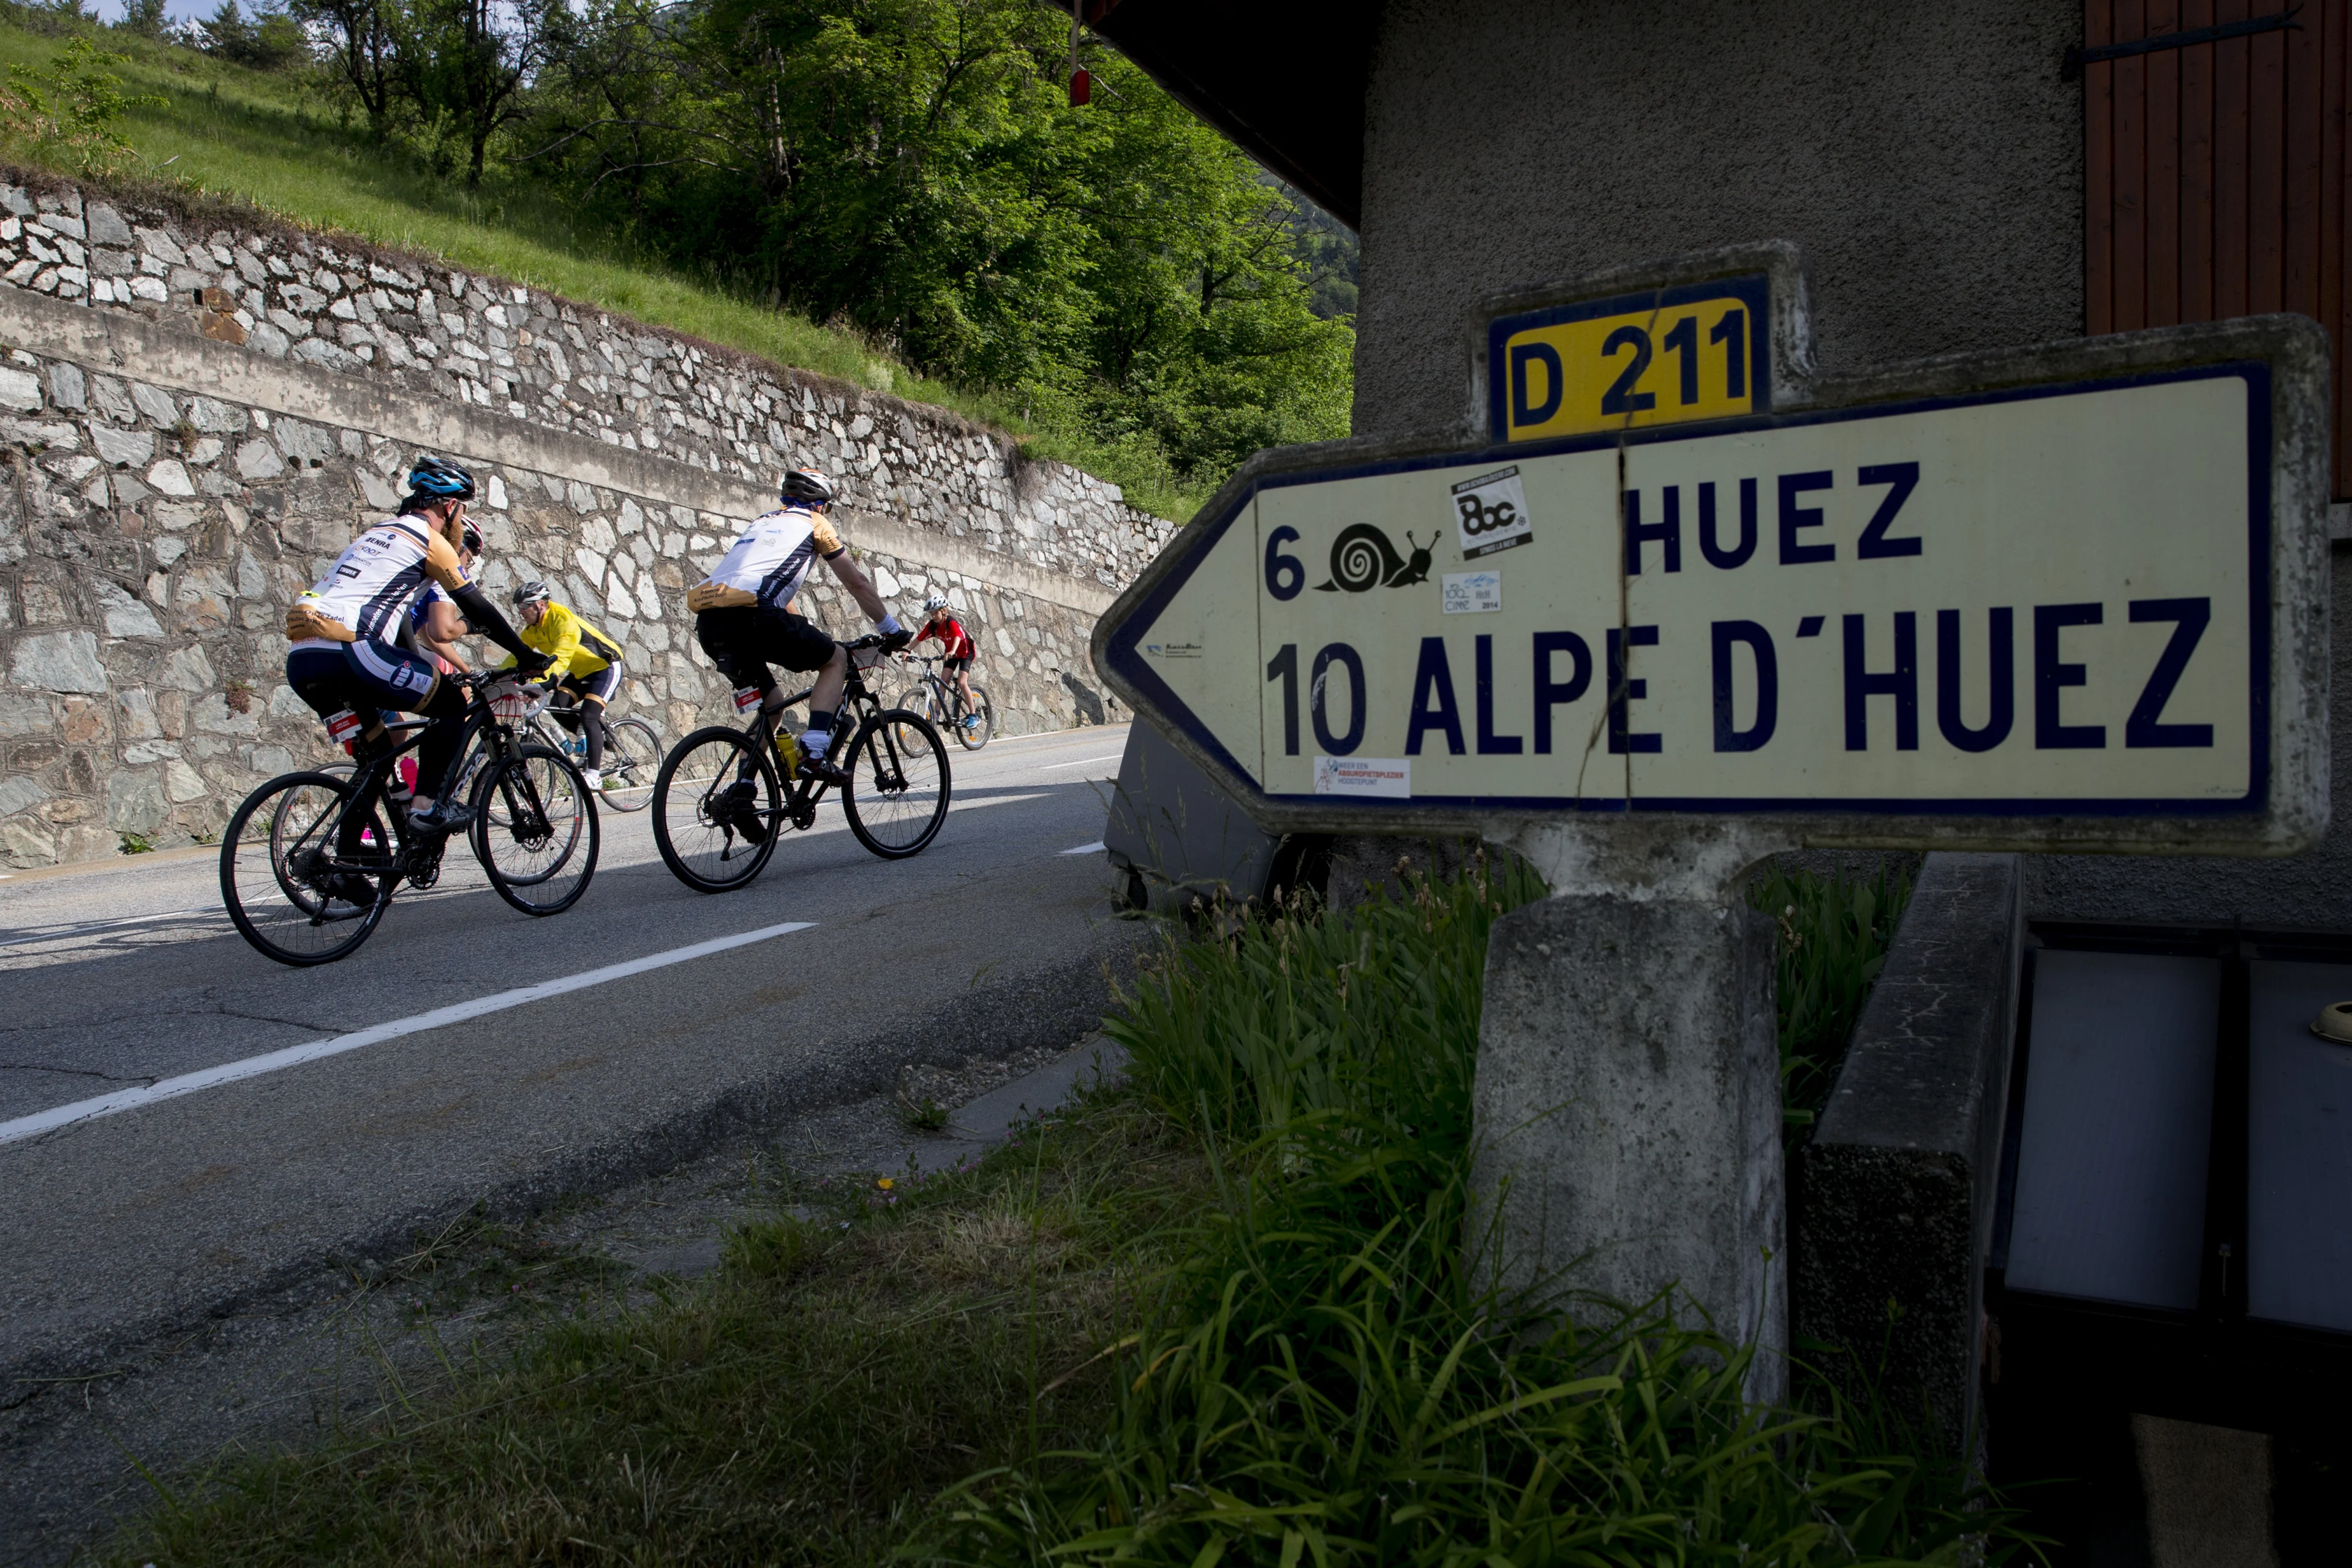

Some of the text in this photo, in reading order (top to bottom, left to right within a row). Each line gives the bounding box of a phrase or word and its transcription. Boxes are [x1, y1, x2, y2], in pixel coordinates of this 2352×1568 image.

[1511, 311, 1746, 428] D 211
[1264, 461, 1923, 601] 6 HUEZ
[339, 567, 358, 576] THULE
[326, 614, 345, 623] Zadel
[1482, 601, 1498, 609] 2014
[1266, 642, 1366, 756] 10
[1404, 625, 1662, 755] ALPE
